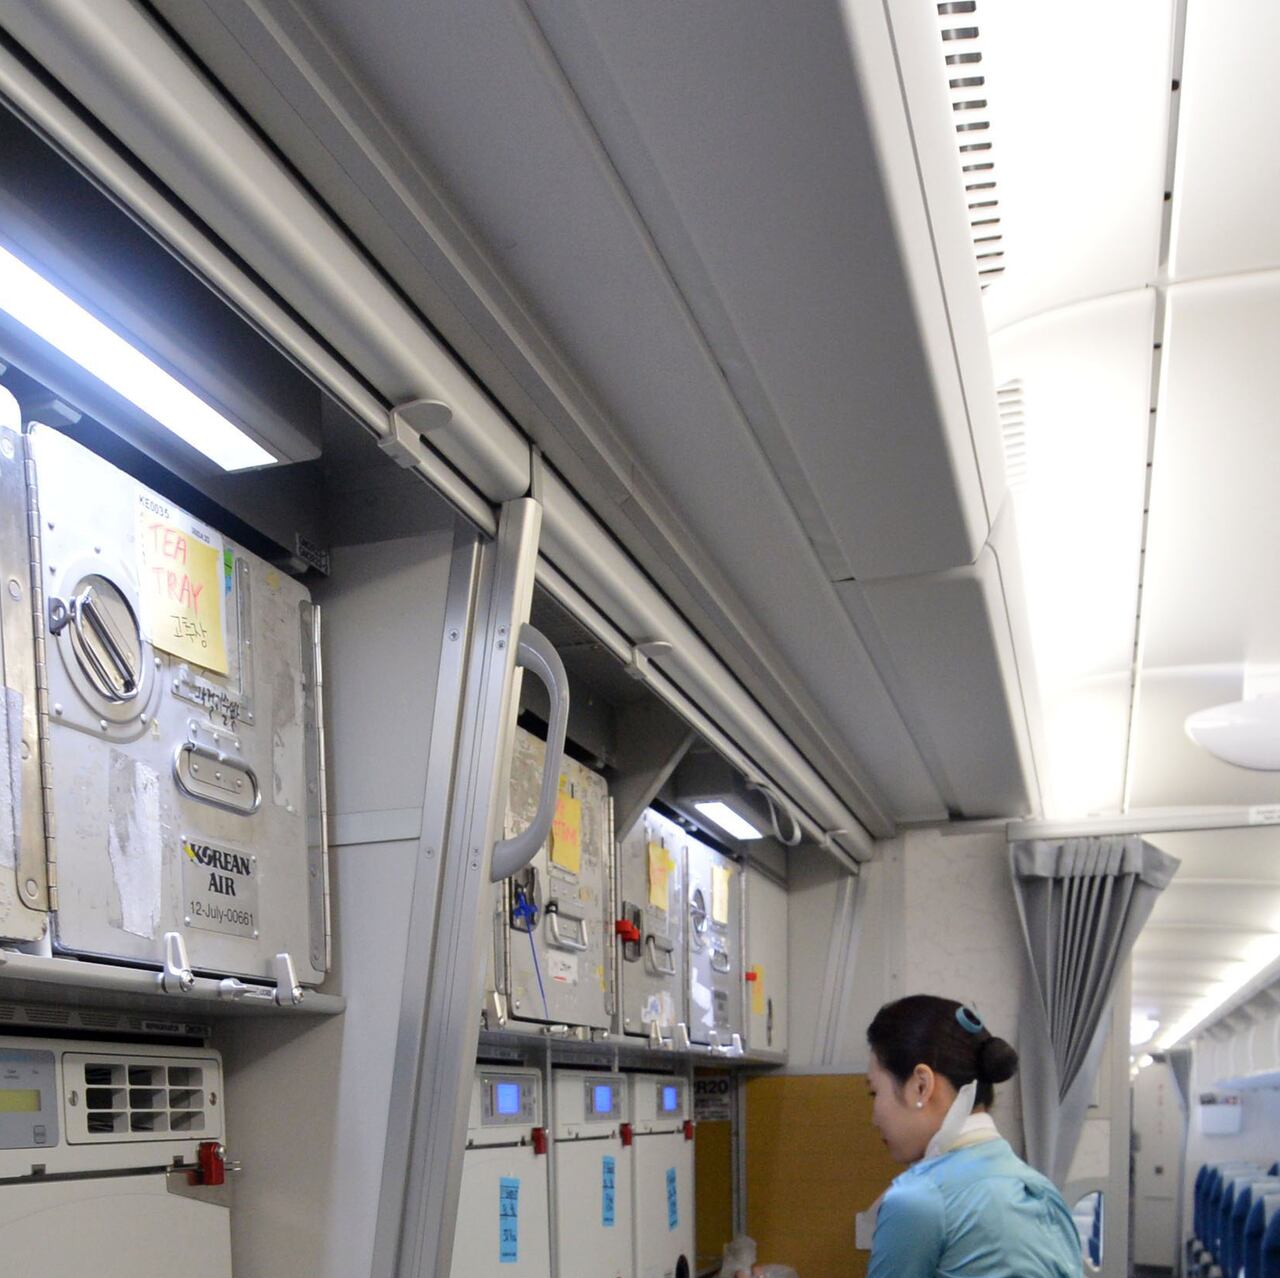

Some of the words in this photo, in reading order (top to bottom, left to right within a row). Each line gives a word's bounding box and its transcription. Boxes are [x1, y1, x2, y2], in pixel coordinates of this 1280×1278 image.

[149, 523, 188, 565] TEA
[152, 567, 204, 616] TRAY
[190, 843, 251, 876] KOREAN
[208, 872, 236, 897] AIR
[190, 901, 254, 927] 12-July-00661
